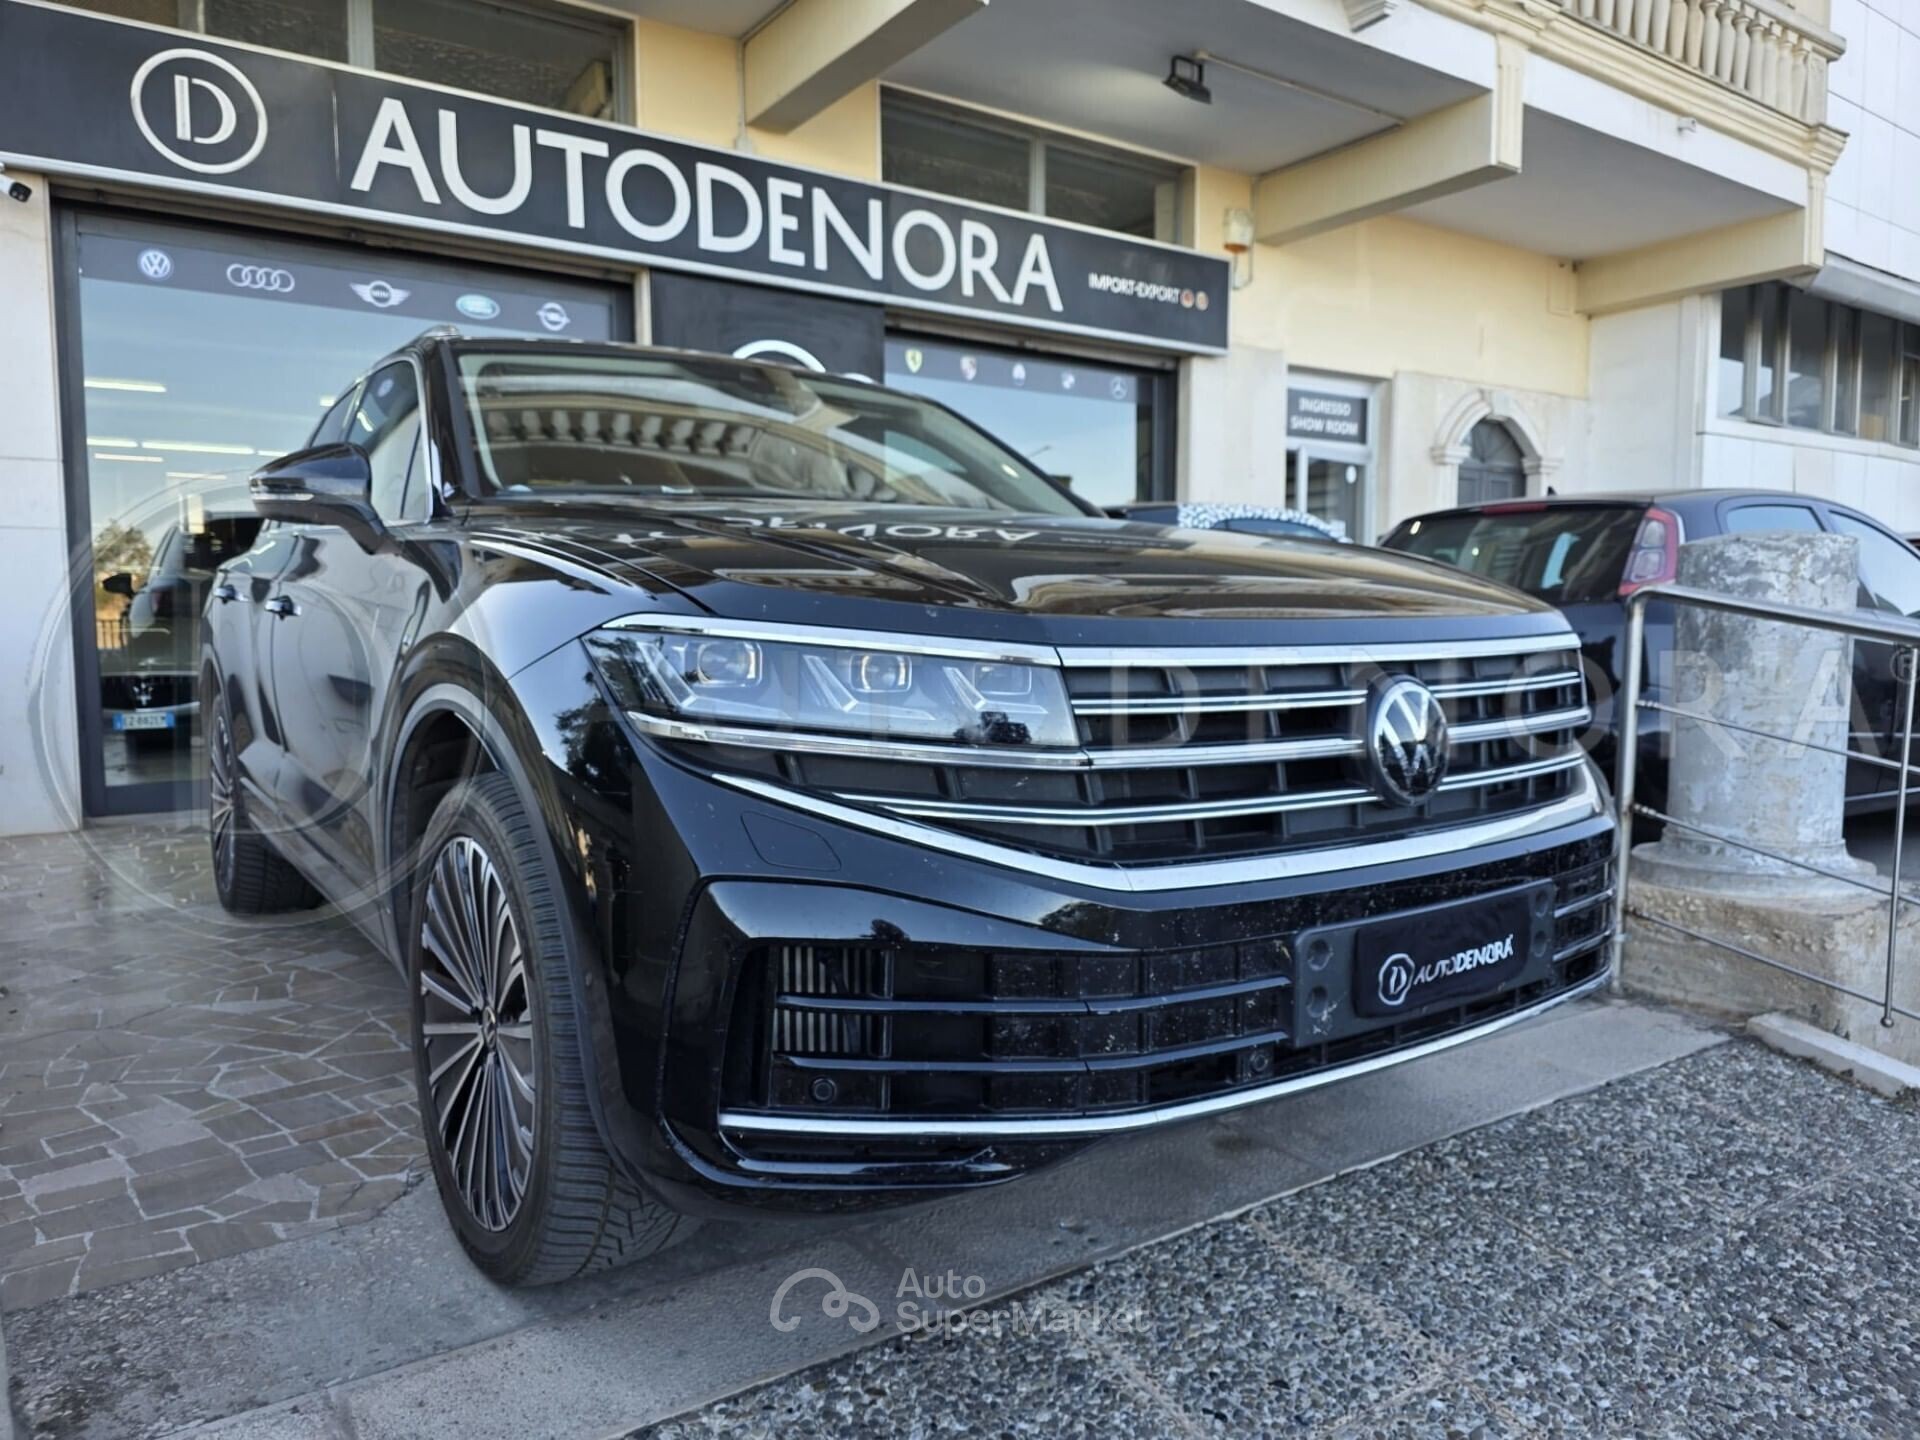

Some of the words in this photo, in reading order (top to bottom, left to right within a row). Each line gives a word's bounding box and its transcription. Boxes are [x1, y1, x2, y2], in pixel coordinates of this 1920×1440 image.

[349, 96, 1065, 313] AUTODENORA
[1087, 272, 1181, 305] IMPORT-EXPORT
[1298, 396, 1352, 417] INGRESSO
[1290, 414, 1325, 433] SHOW
[1324, 418, 1359, 436] ROOM
[1413, 936, 1514, 986] AUTODENORA
